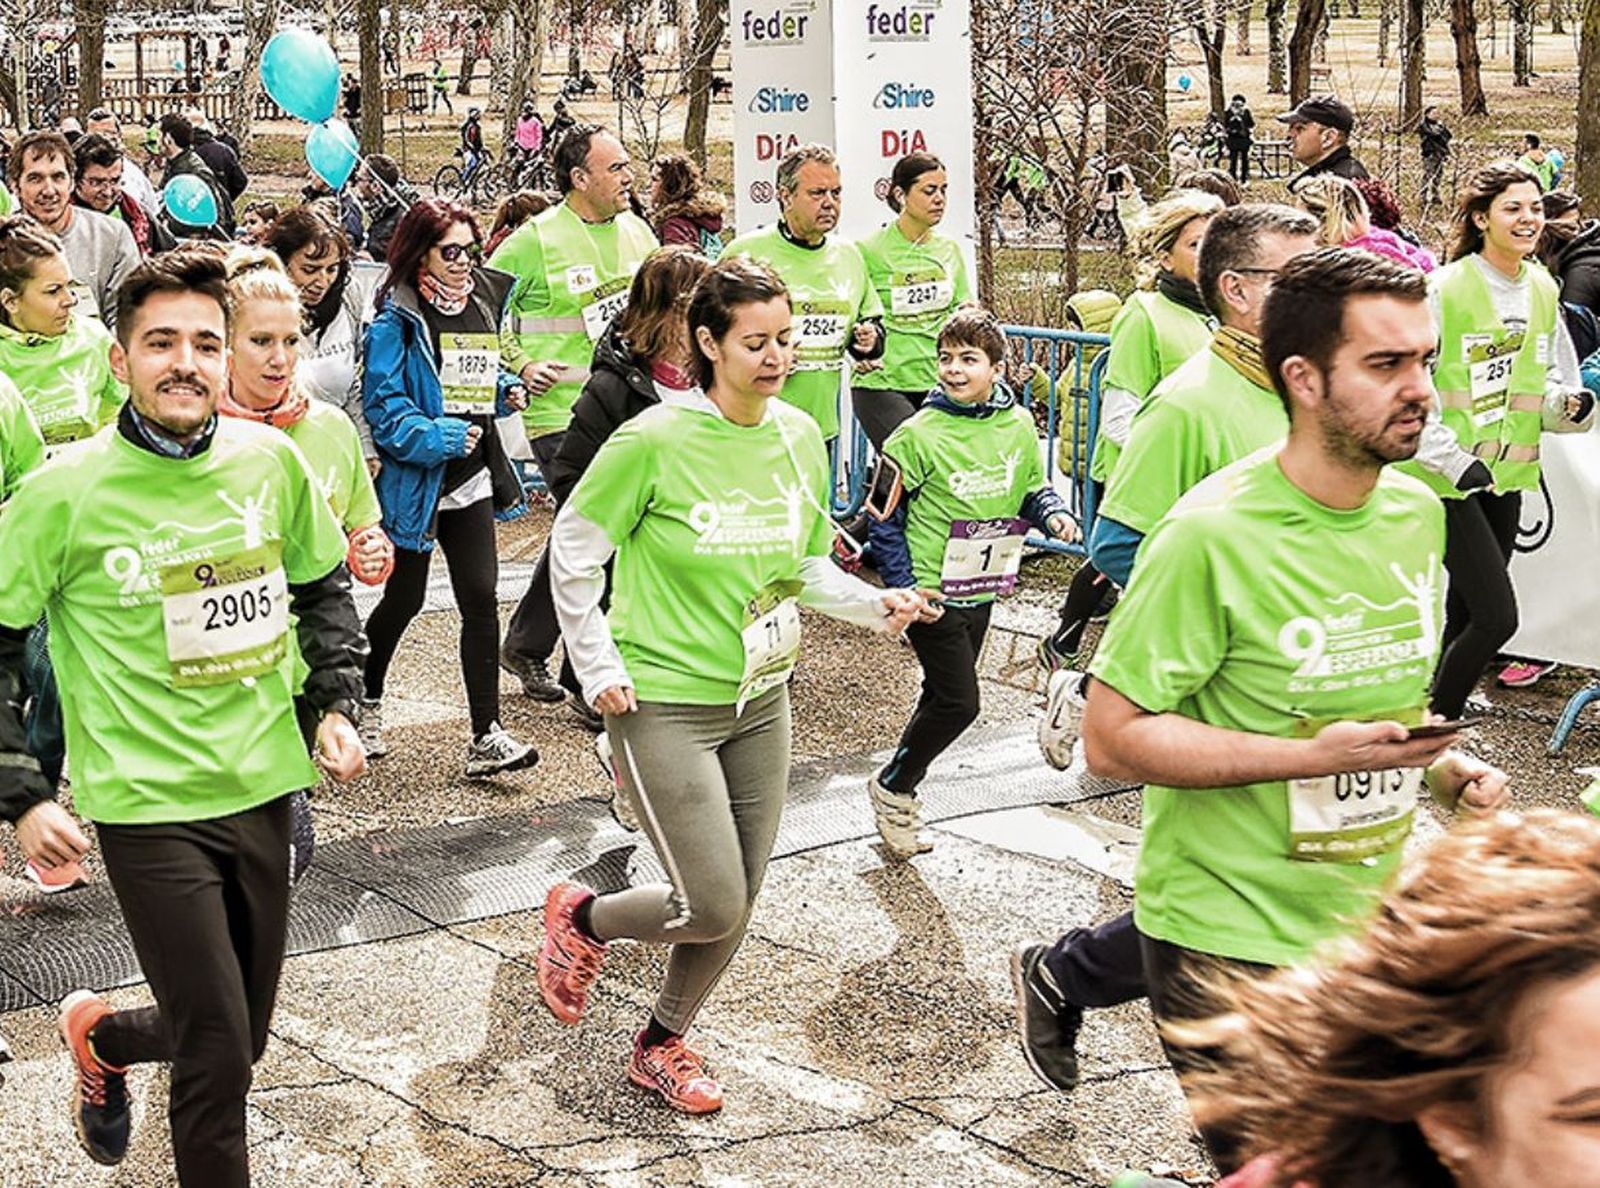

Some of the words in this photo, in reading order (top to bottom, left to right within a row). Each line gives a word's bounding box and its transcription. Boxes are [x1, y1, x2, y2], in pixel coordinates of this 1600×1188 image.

[742, 9, 808, 40] feder
[866, 4, 935, 35] feder
[757, 87, 810, 113] Shire
[882, 83, 935, 110] Shire
[907, 285, 937, 304] 2247
[802, 317, 837, 336] 2524
[458, 355, 487, 373] 1879
[103, 546, 142, 594] 9
[979, 544, 993, 572] 1
[194, 564, 213, 589] 9
[202, 585, 272, 632] 2905
[1277, 615, 1327, 674] 9
